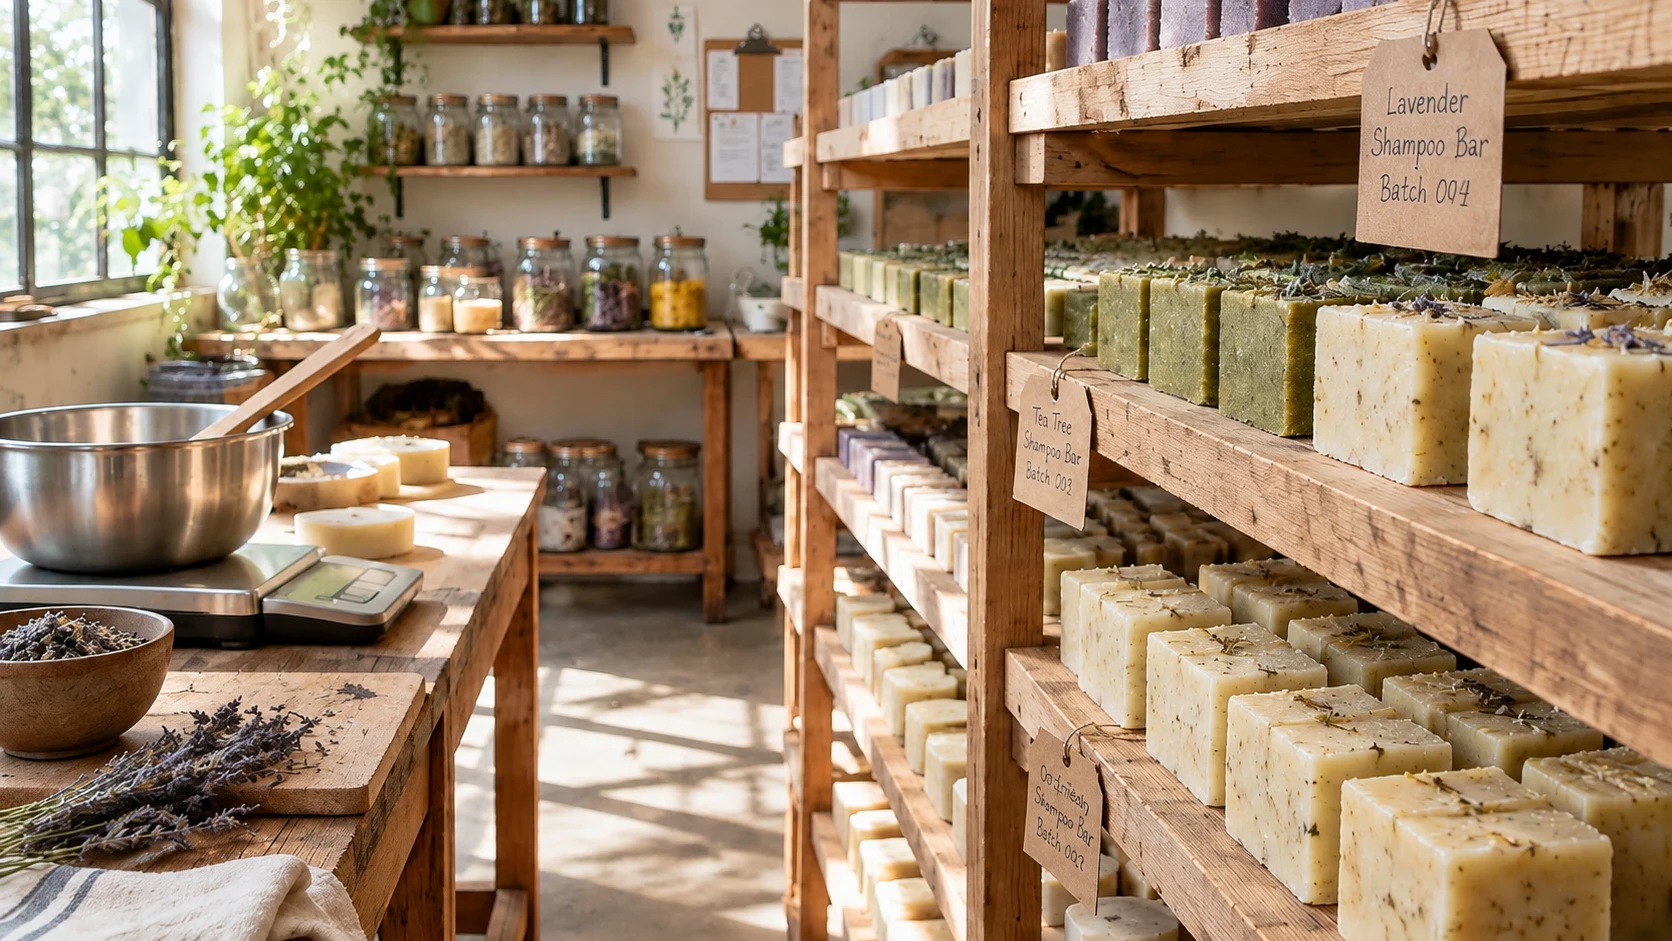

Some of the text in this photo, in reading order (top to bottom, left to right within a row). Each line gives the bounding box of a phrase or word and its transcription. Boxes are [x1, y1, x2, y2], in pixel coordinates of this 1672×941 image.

[1387, 82, 1469, 115] Lavender
[1371, 126, 1489, 170] Shampoo Bar
[1380, 174, 1426, 203] Batch
[1032, 406, 1072, 435] Tea Tree
[1023, 430, 1082, 465] Shampoo Bar
[1026, 460, 1050, 485] Batch
[1034, 785, 1095, 847] Shampoo Bar
[1036, 816, 1061, 852] Batch
